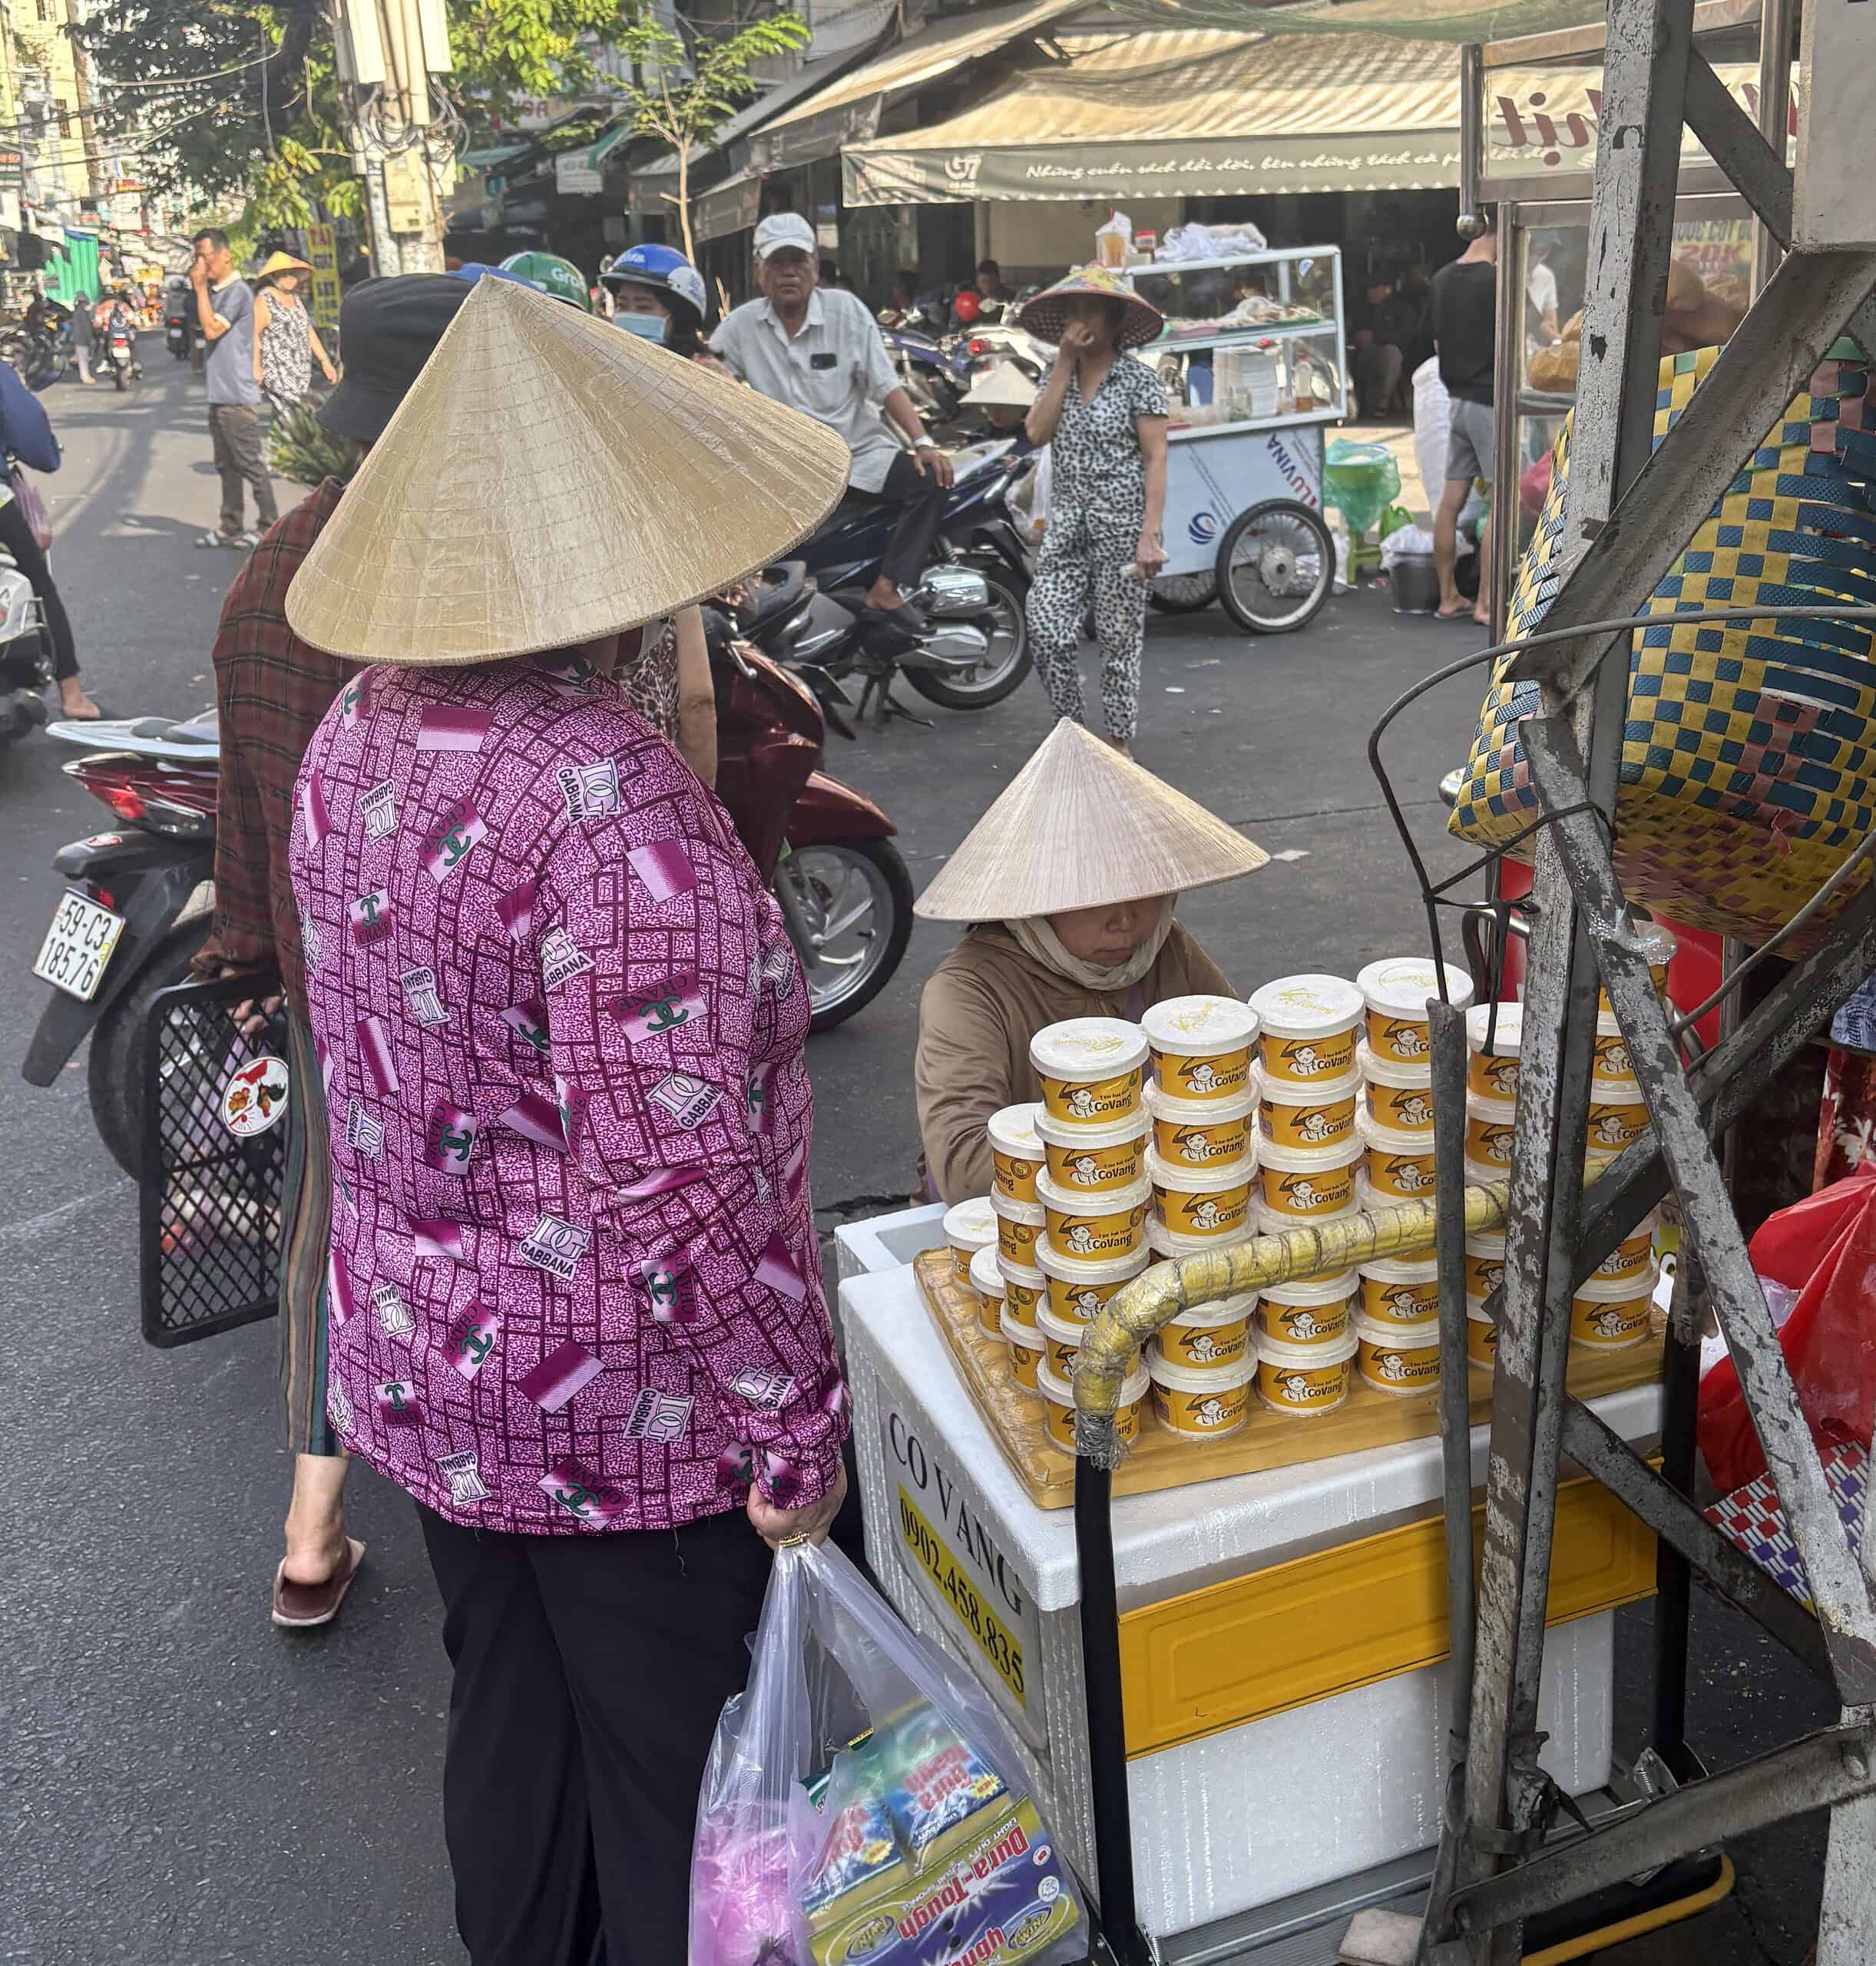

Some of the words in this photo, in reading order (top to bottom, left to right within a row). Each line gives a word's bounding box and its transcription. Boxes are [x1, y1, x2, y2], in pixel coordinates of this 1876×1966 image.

[945, 154, 982, 180] G7
[558, 768, 584, 824] GABBANA
[59, 899, 112, 951] 59-C3
[40, 938, 100, 993] 185.76
[545, 956, 588, 990] ABBANA
[1317, 1052, 1352, 1071] CoVang
[1215, 1071, 1247, 1087] CoVang
[1094, 1094, 1132, 1112] CoVang
[1208, 1138, 1245, 1156] CoVang
[1098, 1160, 1137, 1180] CoVang
[1314, 1186, 1352, 1204] CoVang
[1092, 1233, 1133, 1249] CoVang
[519, 1241, 576, 1278] GABBANA
[1415, 1300, 1438, 1313] CoVa
[1214, 1337, 1246, 1356] CoVang
[1307, 1380, 1342, 1398] CoVang
[626, 1389, 657, 1439] GABBANA
[889, 1412, 928, 1489] CO
[934, 1462, 1024, 1617] VANG
[899, 1498, 1025, 1694] 0902.458.835
[993, 1817, 1017, 1840] LIGHT
[897, 1825, 1030, 1940] Dura-Tough
